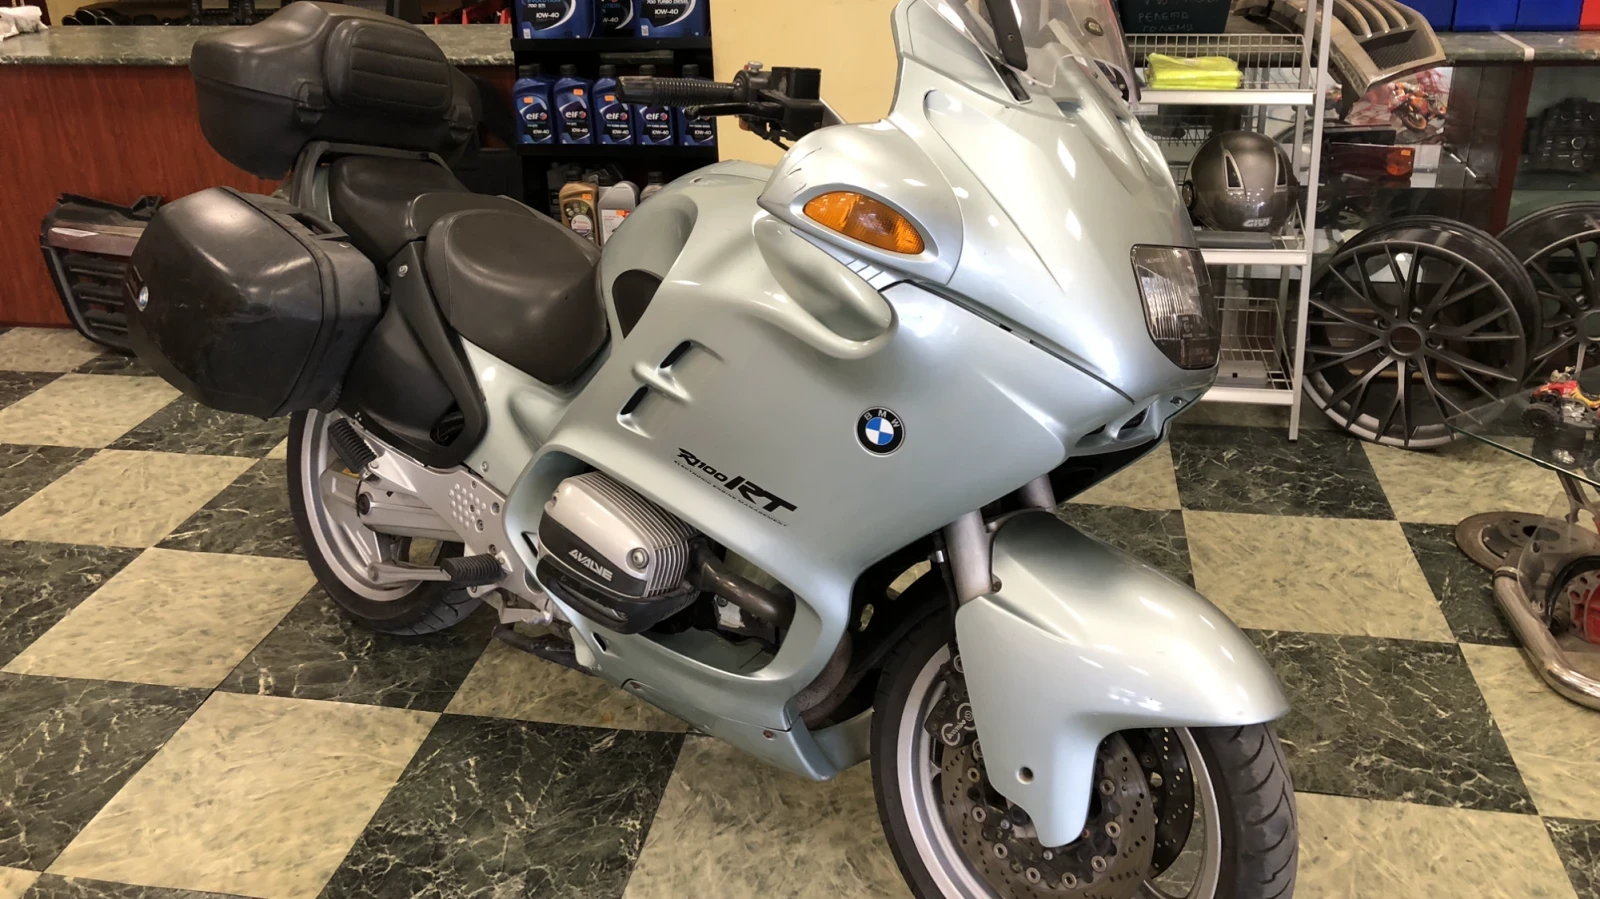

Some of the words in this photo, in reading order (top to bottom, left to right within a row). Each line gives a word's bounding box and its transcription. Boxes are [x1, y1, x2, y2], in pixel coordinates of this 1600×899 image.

[526, 112, 539, 120] elf
[606, 112, 619, 120] elf
[645, 112, 659, 120] elf
[1243, 217, 1272, 227] GIVI
[863, 409, 901, 428] BMW
